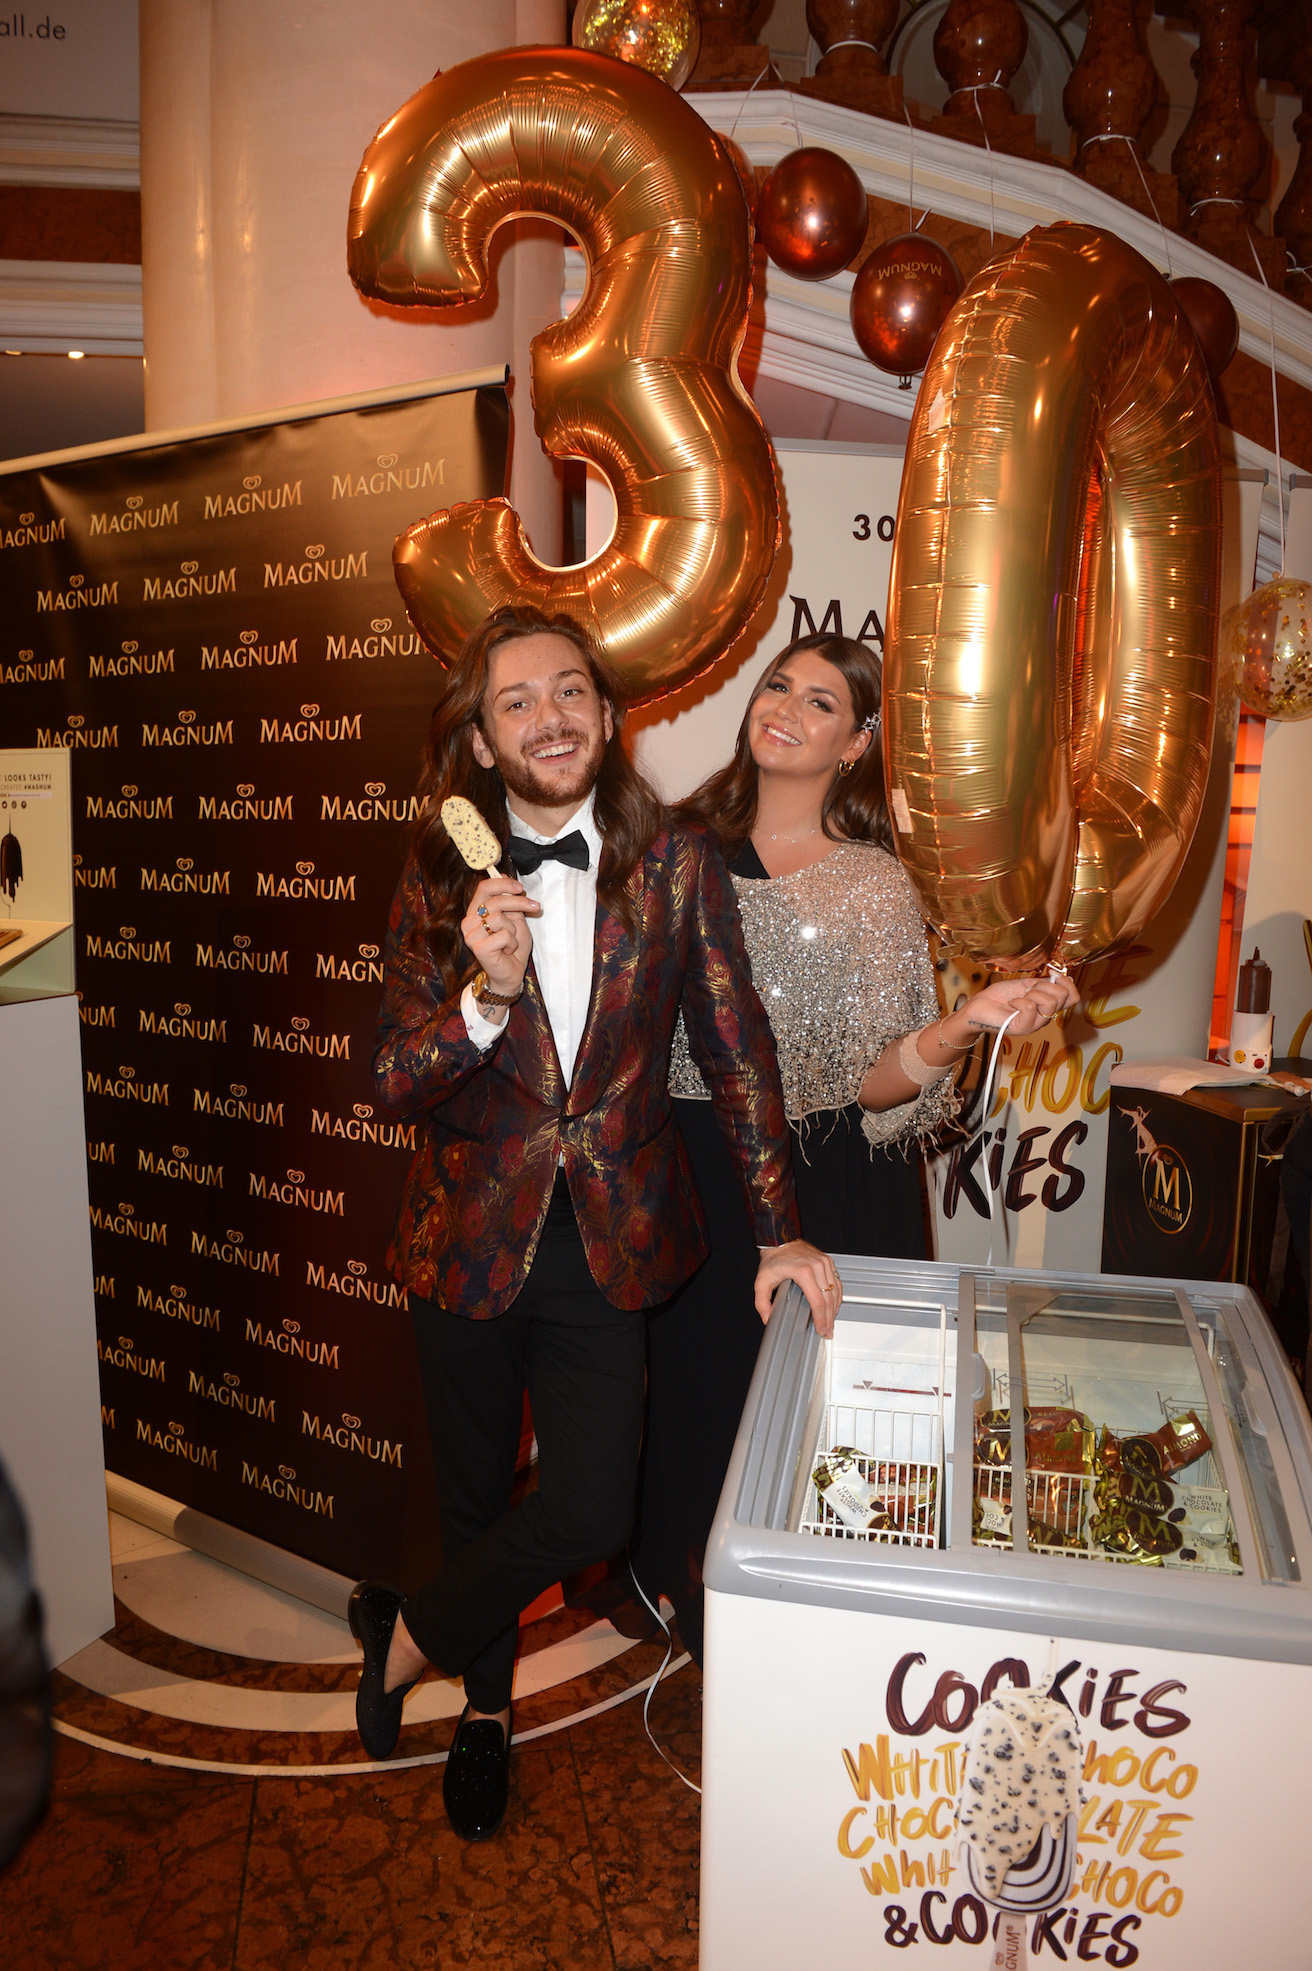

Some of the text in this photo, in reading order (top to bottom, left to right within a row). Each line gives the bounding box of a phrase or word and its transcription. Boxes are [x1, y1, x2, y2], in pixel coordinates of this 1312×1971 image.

[878, 261, 943, 281] MAGNUM
[0, 459, 445, 549] AGNUM MAGNUM MAGNUM MAGNUM
[852, 514, 896, 542] 30
[37, 551, 368, 612] MAGNUM MAGNUM MAGNUM
[0, 657, 65, 684] AGNUM
[89, 649, 175, 678] MAGNUM
[201, 639, 298, 671] MAGNUM
[37, 714, 362, 749] MAGNUM MAGNUM MAGNUM
[86, 794, 431, 821] MAGNUM MAGNUM MAGNUM
[74, 867, 356, 901] NUM MAGNUM MAGNUM
[86, 934, 384, 983] MAGNUM MAGNUM MAGN
[79, 1006, 351, 1061] NUM MAGNUM MAGNUM
[86, 1071, 417, 1151] MAGNUM MAGNUM MAGNUM
[138, 1149, 224, 1190] MAGNUM
[249, 1172, 345, 1217] MAGNUM
[1153, 1159, 1180, 1211] M
[1148, 1198, 1183, 1225] MAGNUM
[89, 1205, 410, 1312] MAGNUM MAGNUM MAGNUM
[136, 1285, 221, 1332] MAGNUM
[245, 1318, 340, 1370] MAGNUM
[188, 1370, 276, 1423] MAGNUM
[301, 1410, 403, 1469] MAGNUM
[1163, 1432, 1202, 1455] ALMOND
[136, 1419, 334, 1519] MAGNUM MAGNUM
[1125, 1495, 1166, 1512] MAGNUM
[1190, 1494, 1212, 1502] WHITE
